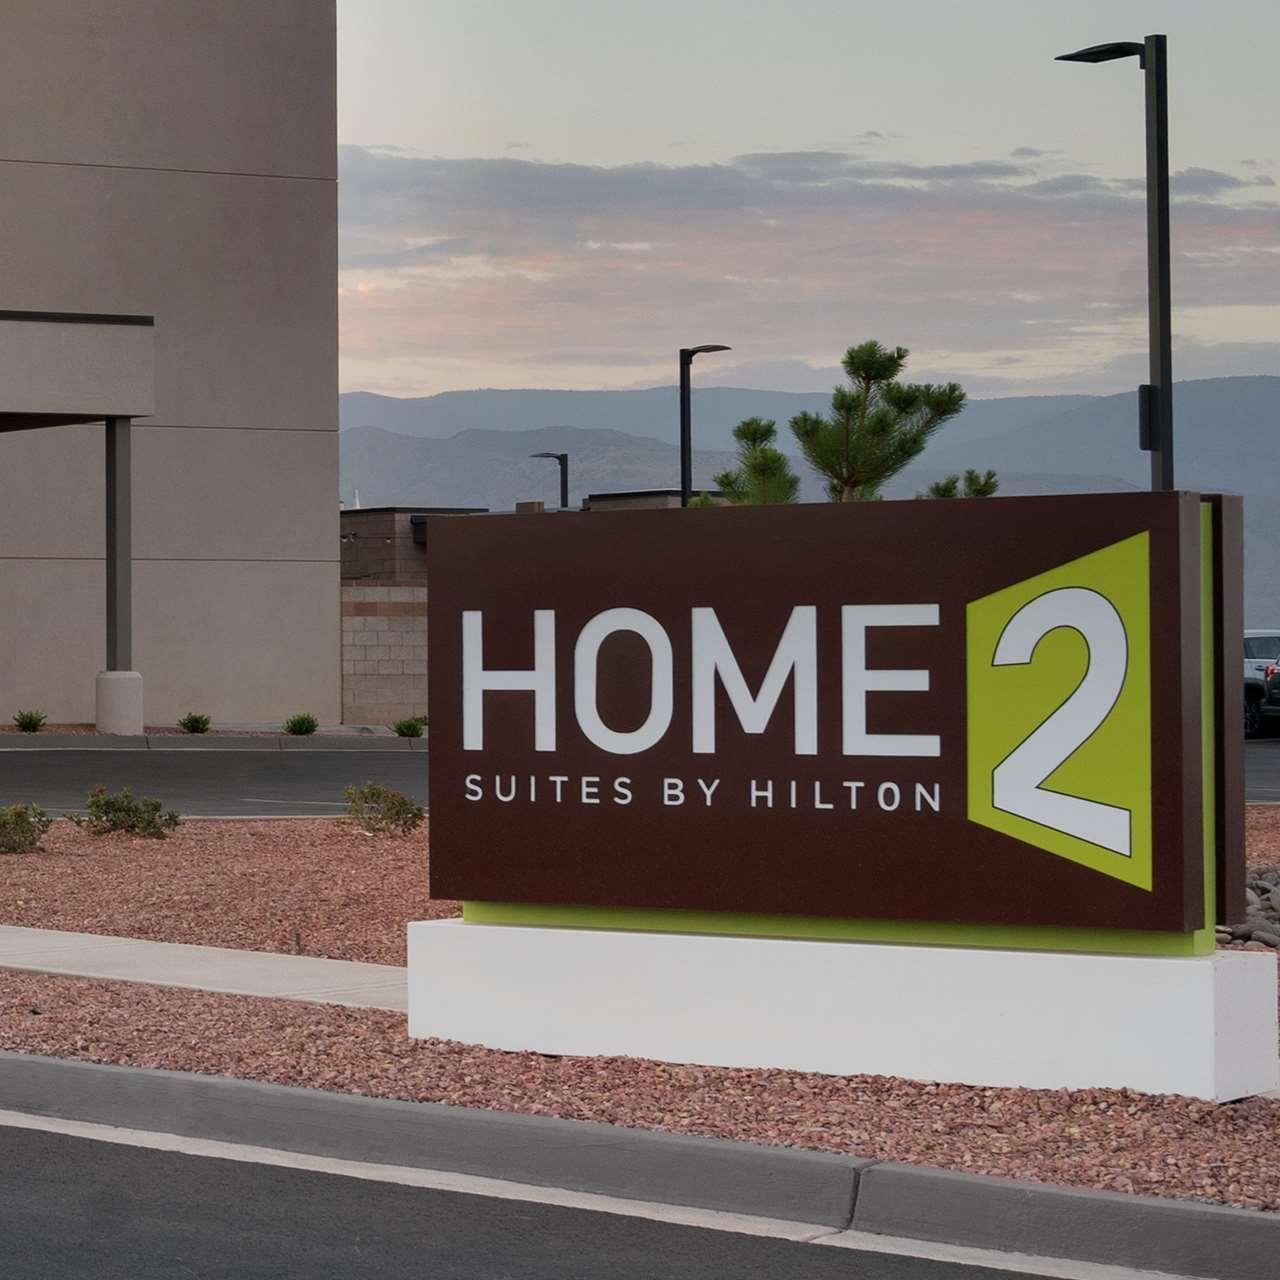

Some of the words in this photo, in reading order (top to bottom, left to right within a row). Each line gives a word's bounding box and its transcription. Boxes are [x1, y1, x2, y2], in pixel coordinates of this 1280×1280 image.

[462, 603, 941, 757] HOME
[991, 586, 1133, 858] 2
[464, 773, 634, 805] SUITES
[663, 777, 721, 807] BY
[750, 779, 942, 812] HILTON
